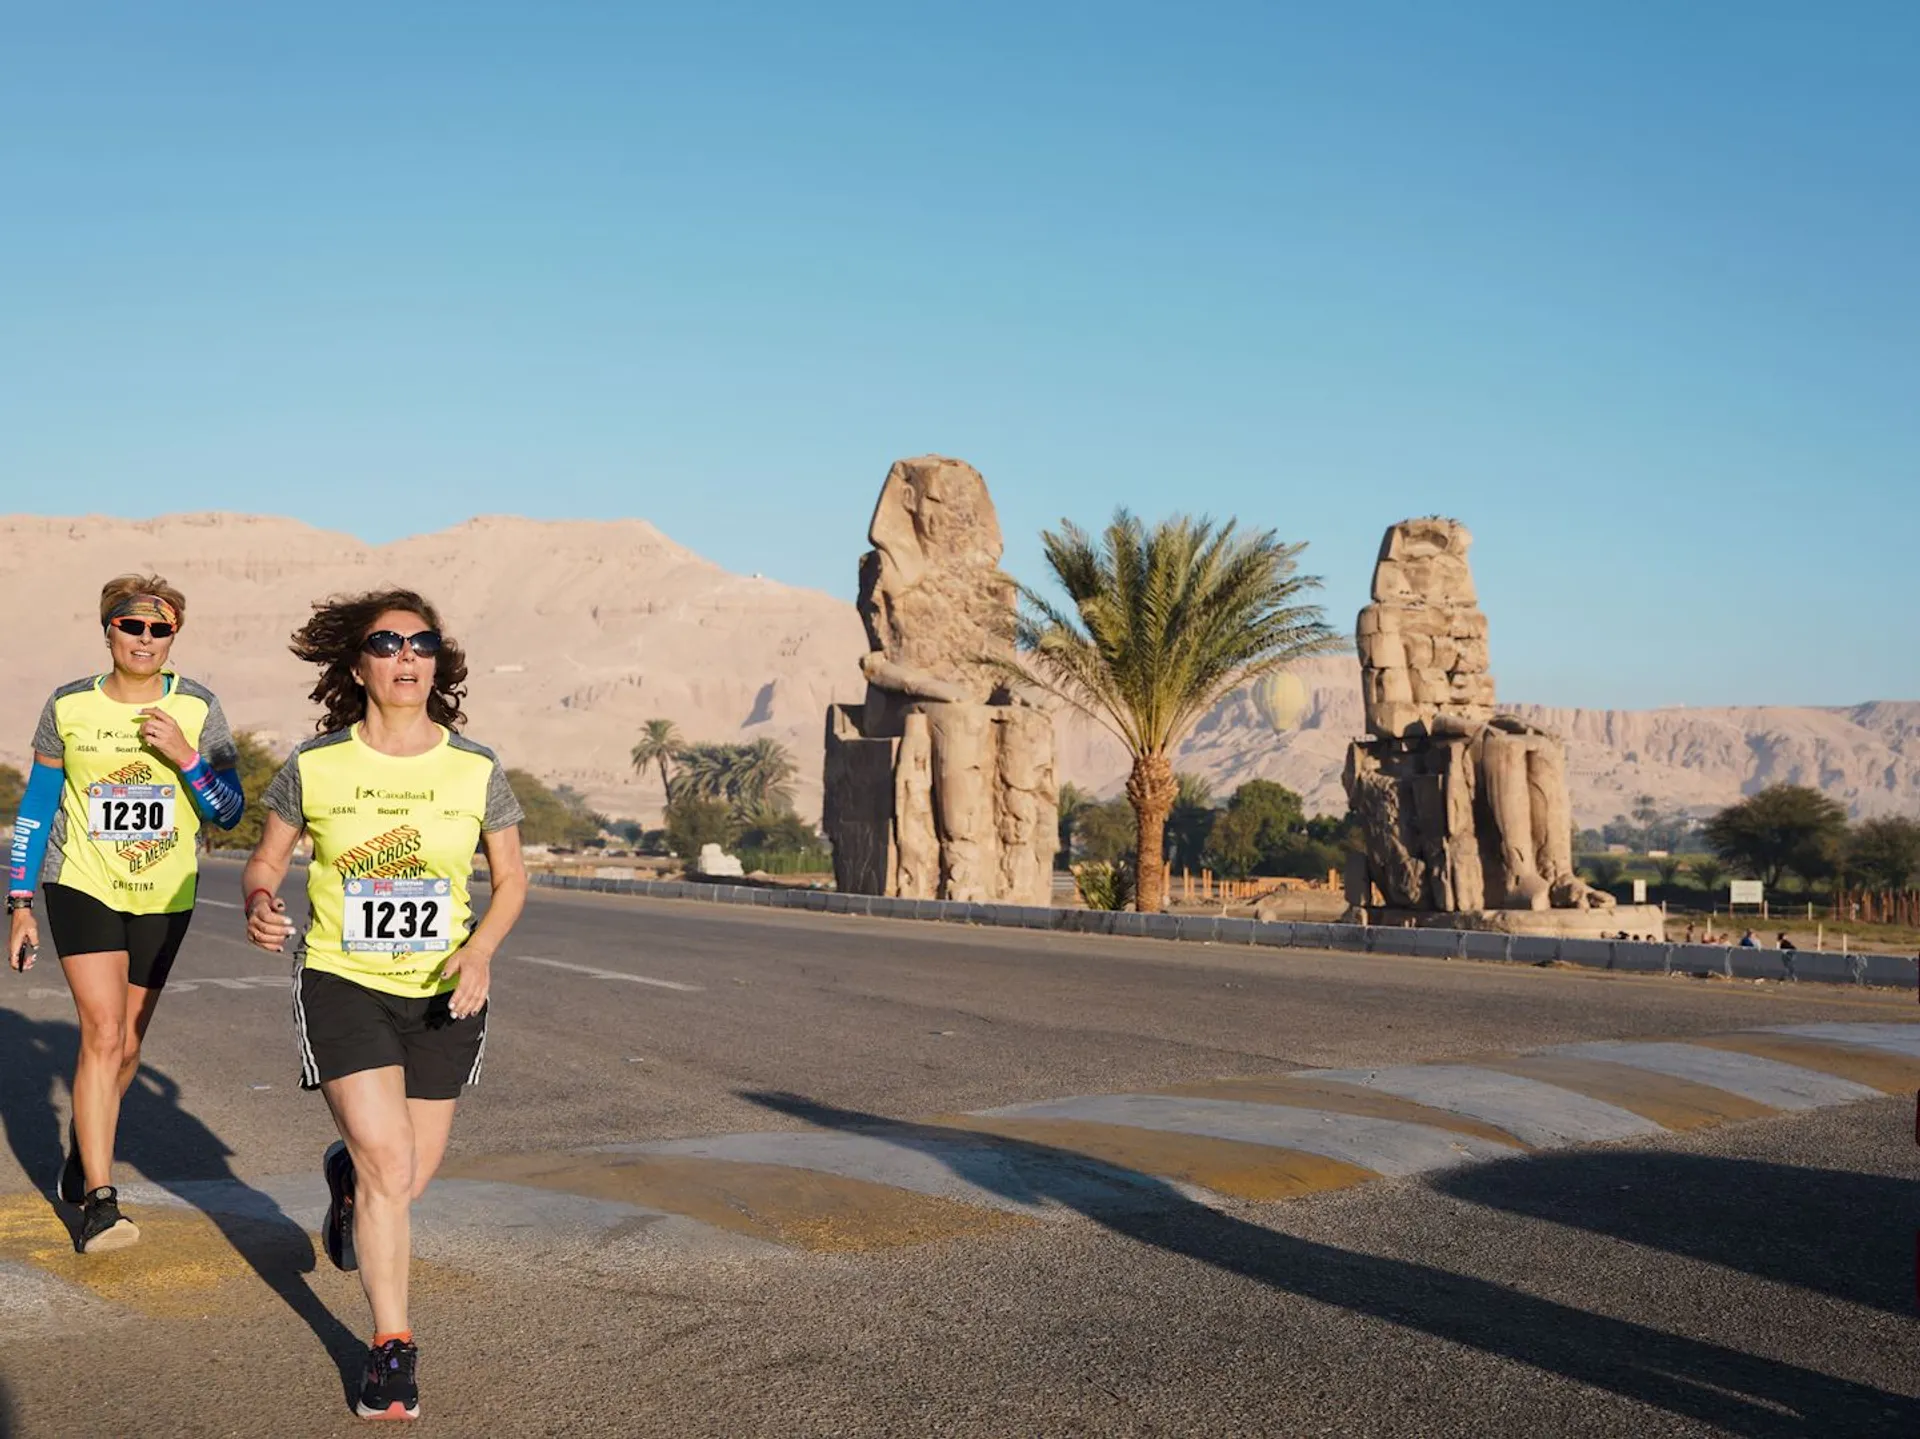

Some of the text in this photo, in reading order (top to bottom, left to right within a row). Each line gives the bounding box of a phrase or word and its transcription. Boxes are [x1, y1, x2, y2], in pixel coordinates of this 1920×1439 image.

[102, 801, 164, 831] 1230
[364, 824, 419, 852] CROSS
[377, 834, 422, 866] CROSS
[129, 856, 143, 873] DE
[113, 880, 155, 892] CRISTINA
[362, 900, 438, 939] 1232
